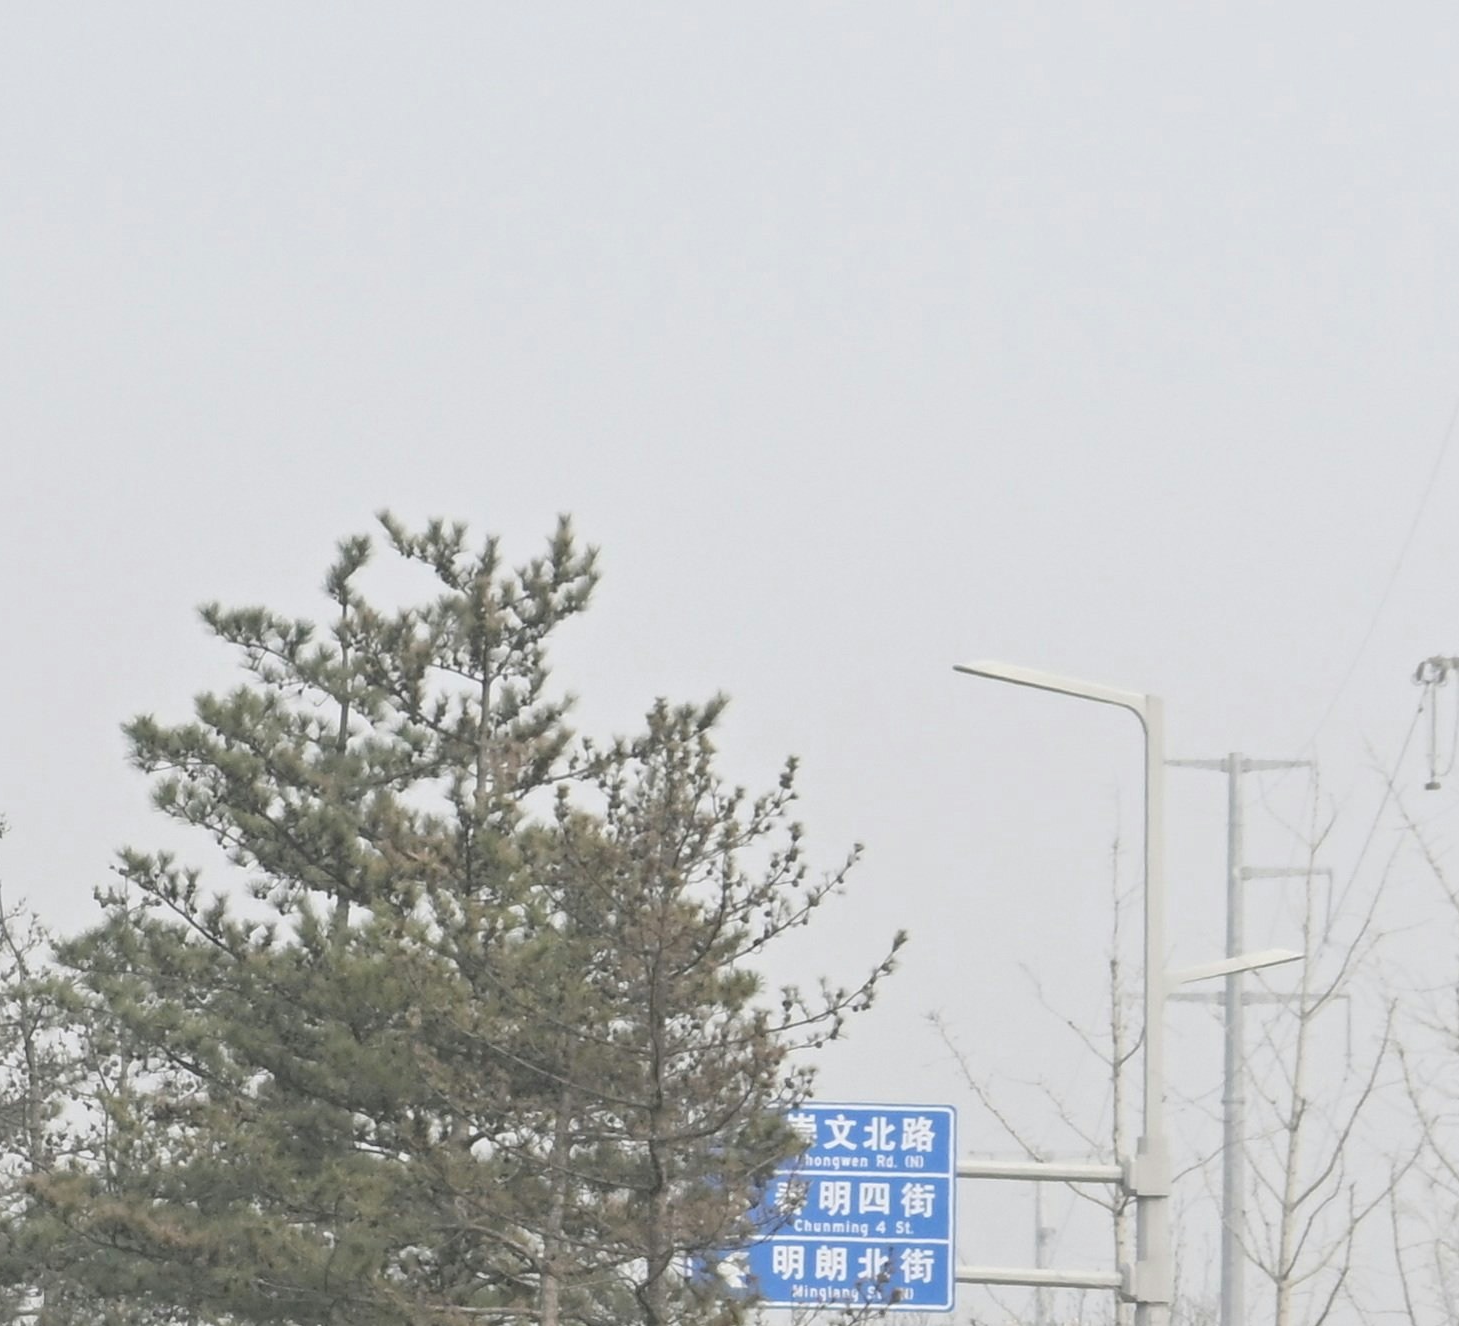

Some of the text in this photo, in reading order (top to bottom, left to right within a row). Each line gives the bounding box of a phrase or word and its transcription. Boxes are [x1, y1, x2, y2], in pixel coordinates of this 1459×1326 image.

[795, 1154, 924, 1170] hongwen Rd. (N)
[793, 1219, 914, 1237] Chunming 4 St.
[773, 1245, 935, 1283] 明朗北街
